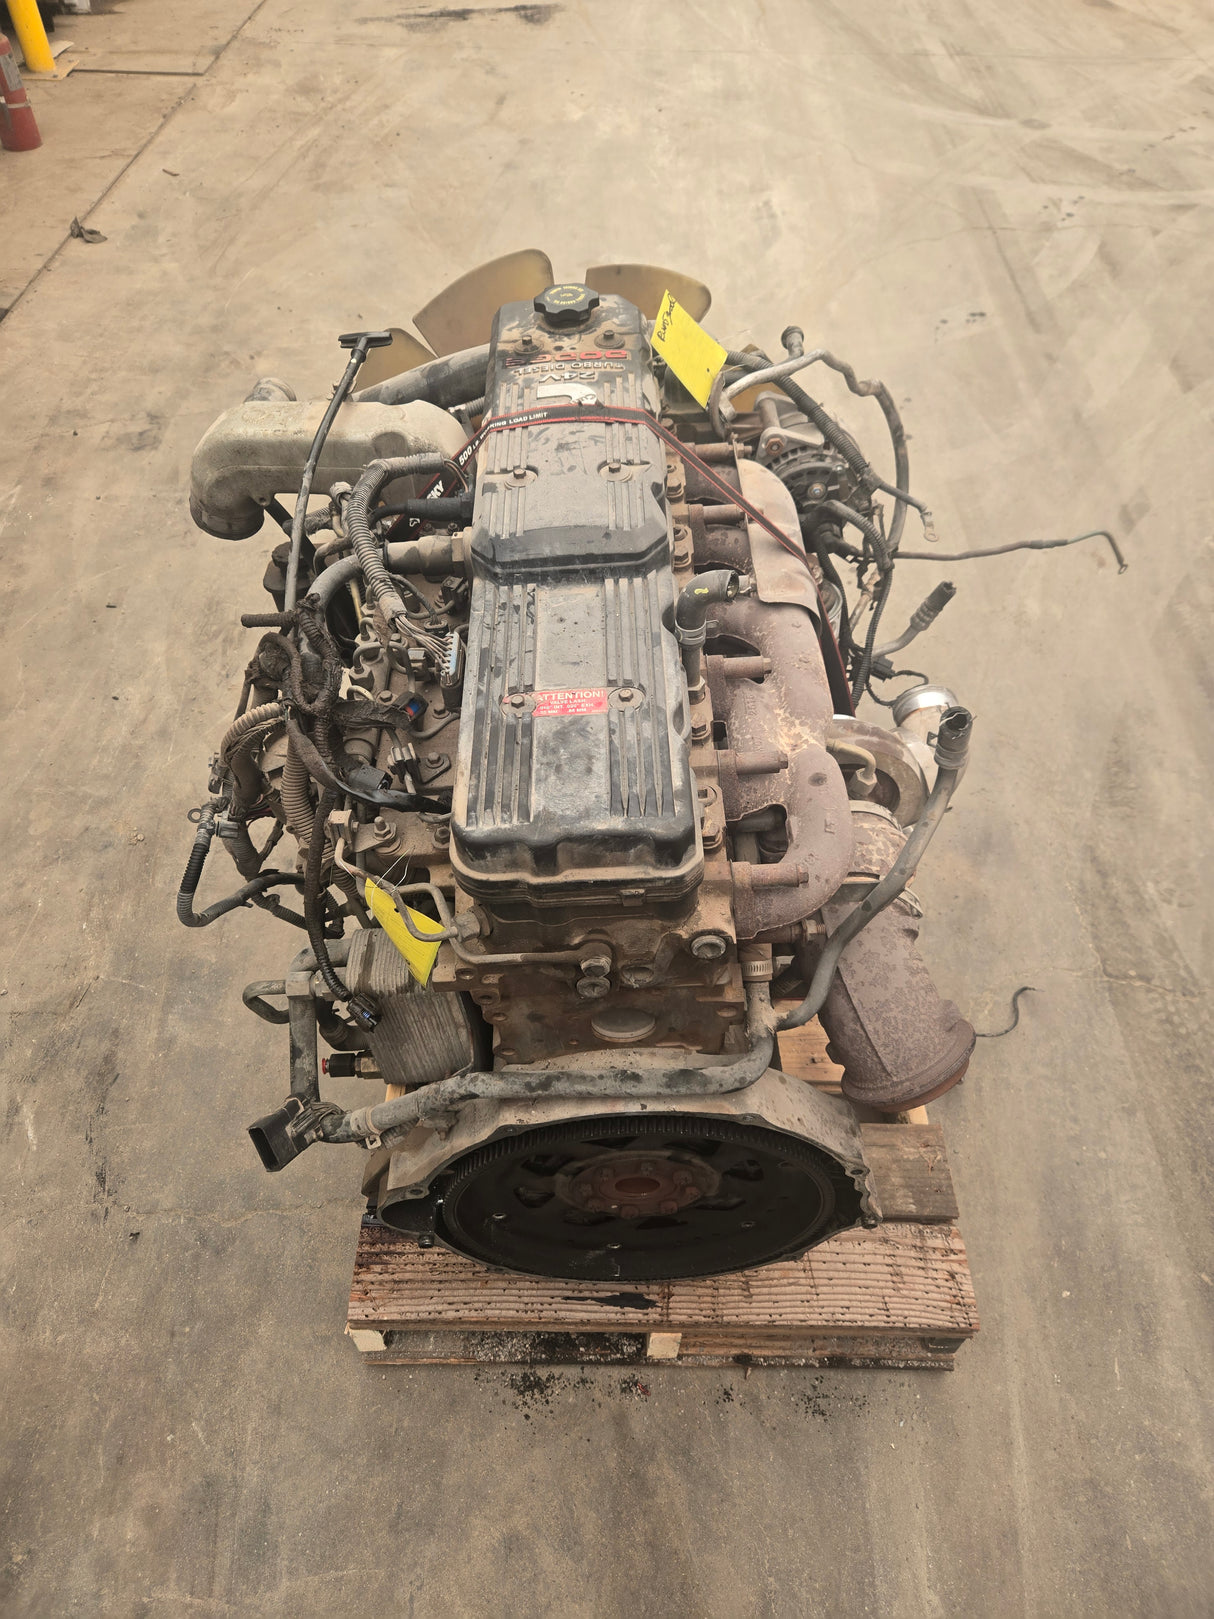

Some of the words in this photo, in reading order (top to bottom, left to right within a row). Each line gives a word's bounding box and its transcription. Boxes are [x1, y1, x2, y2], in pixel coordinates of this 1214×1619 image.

[513, 361, 565, 376] DIESEL
[571, 361, 624, 370] TURBO
[538, 371, 596, 383] 24V
[459, 447, 473, 466] 500
[509, 416, 527, 424] LOAD
[529, 412, 548, 420] LIMIT
